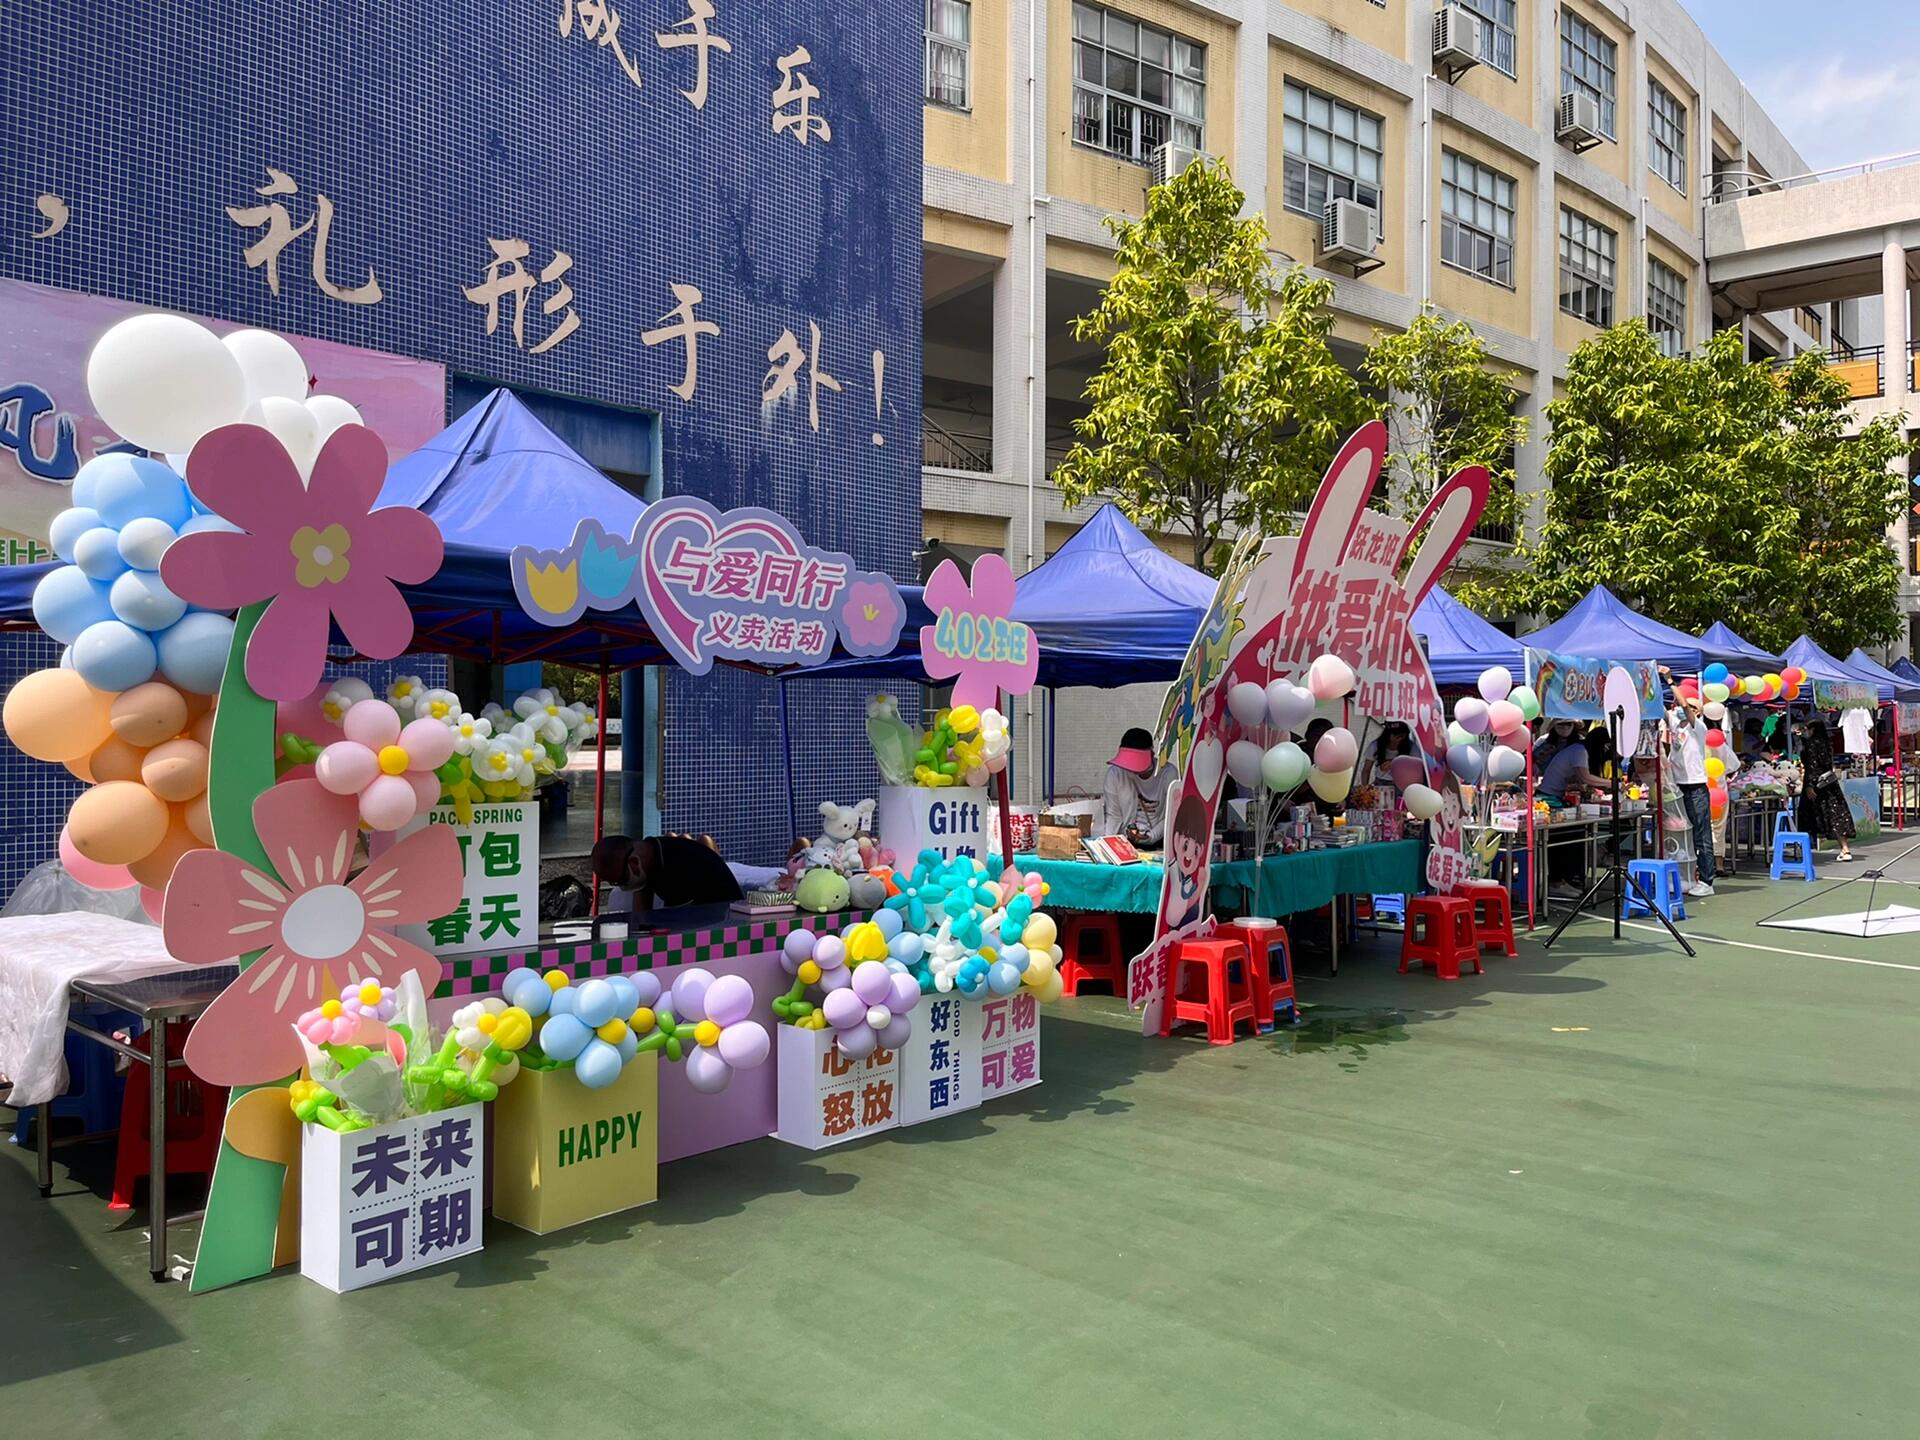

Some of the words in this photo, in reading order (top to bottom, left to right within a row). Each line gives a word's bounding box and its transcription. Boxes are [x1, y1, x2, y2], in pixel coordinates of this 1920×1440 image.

[662, 540, 845, 608] 与爱同行
[705, 614, 825, 652] 义卖活动
[934, 606, 1028, 665] 402班
[1359, 680, 1416, 720] 401班
[473, 808, 523, 824] SPRING
[929, 801, 980, 835] Gift
[427, 893, 521, 947] 春天
[953, 1000, 961, 1038] GOOD
[981, 992, 1037, 1042] 万物
[929, 1000, 951, 1110] 好东西
[953, 1049, 961, 1101] THINGS
[981, 1040, 1036, 1090] 可爱
[822, 1079, 894, 1137] 怒放
[350, 1118, 474, 1198] 未来
[558, 1111, 643, 1168] HAPPY
[351, 1187, 473, 1269] 可期
